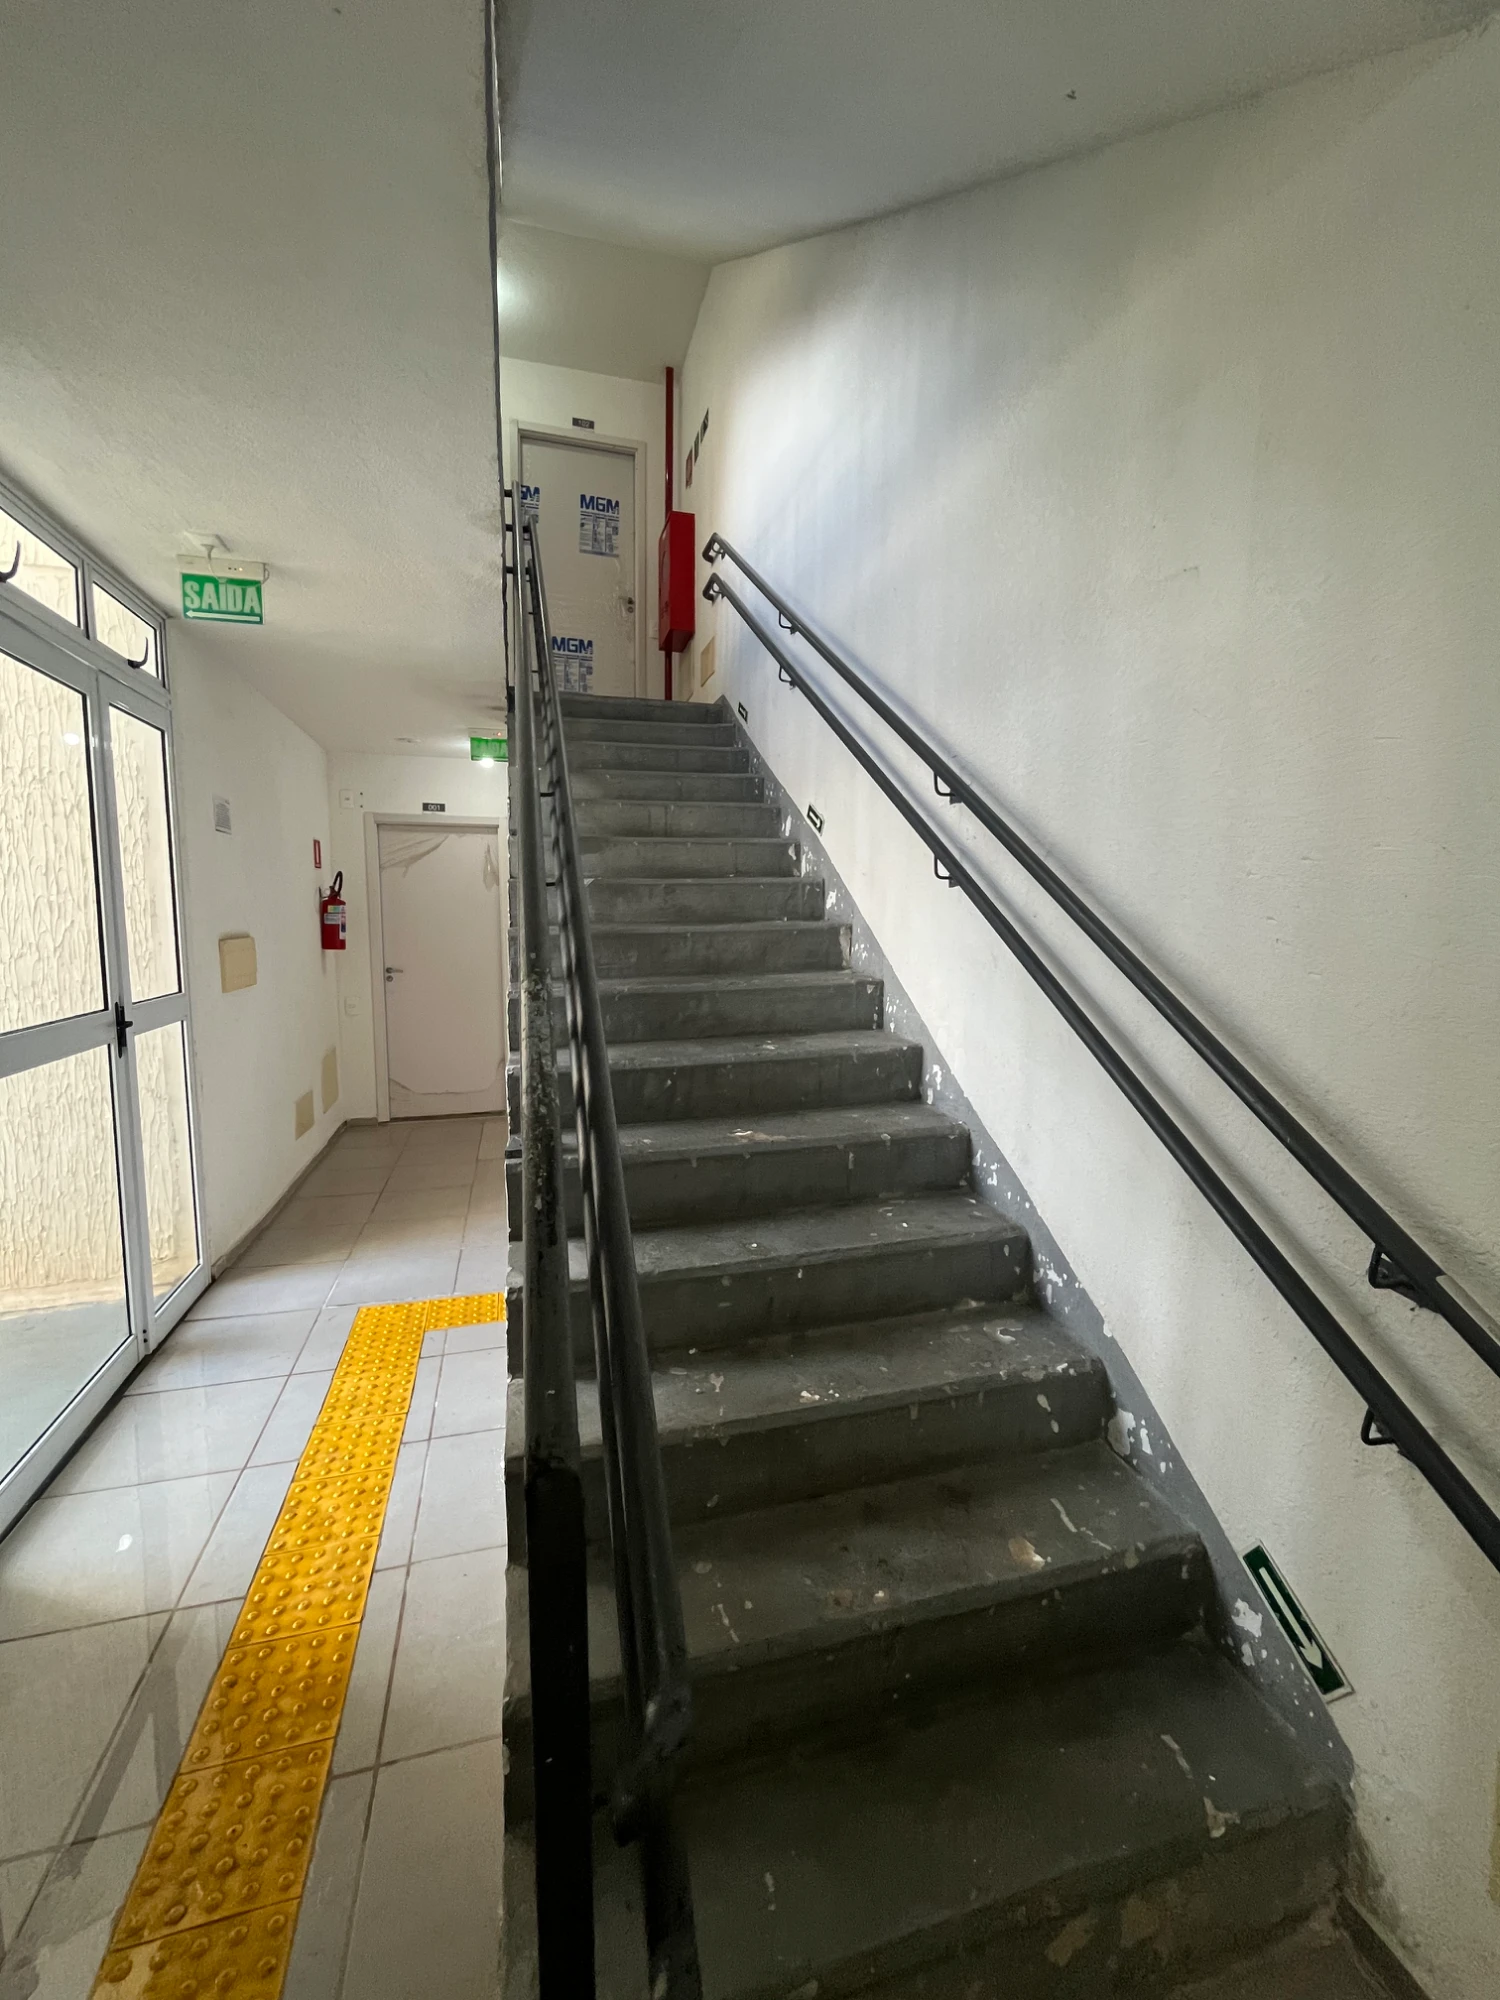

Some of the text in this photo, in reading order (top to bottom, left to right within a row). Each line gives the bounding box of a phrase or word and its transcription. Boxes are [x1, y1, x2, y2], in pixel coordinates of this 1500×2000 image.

[521, 485, 540, 502] GM
[580, 494, 620, 515] MGM
[184, 578, 261, 614] SAÍDA
[552, 636, 593, 655] MGM
